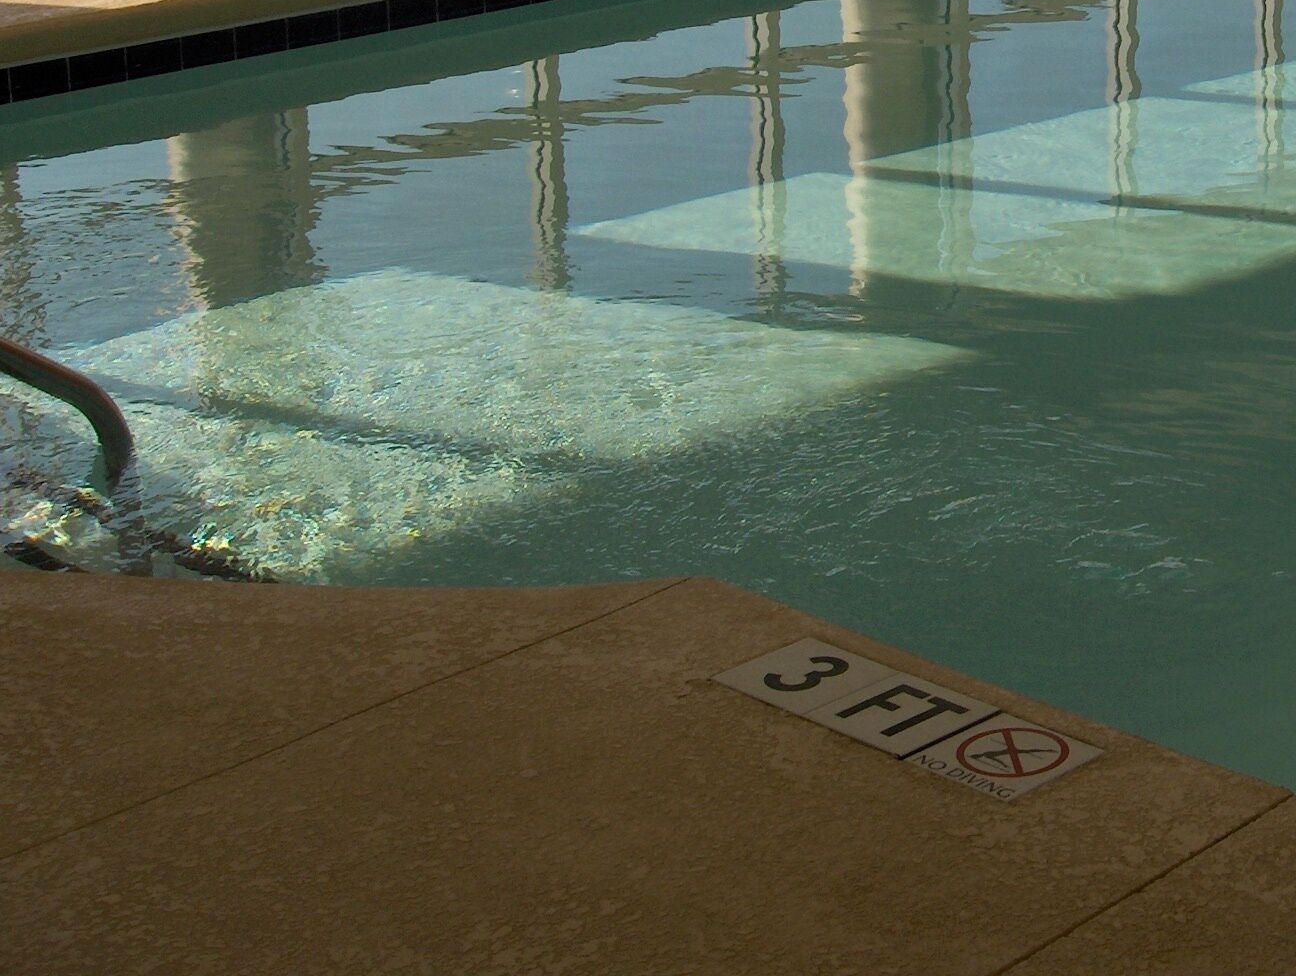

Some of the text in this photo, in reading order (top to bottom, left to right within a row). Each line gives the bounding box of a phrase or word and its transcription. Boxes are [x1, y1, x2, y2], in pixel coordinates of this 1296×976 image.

[763, 655, 970, 738] 3 FT
[912, 754, 1017, 799] NO DIVING
